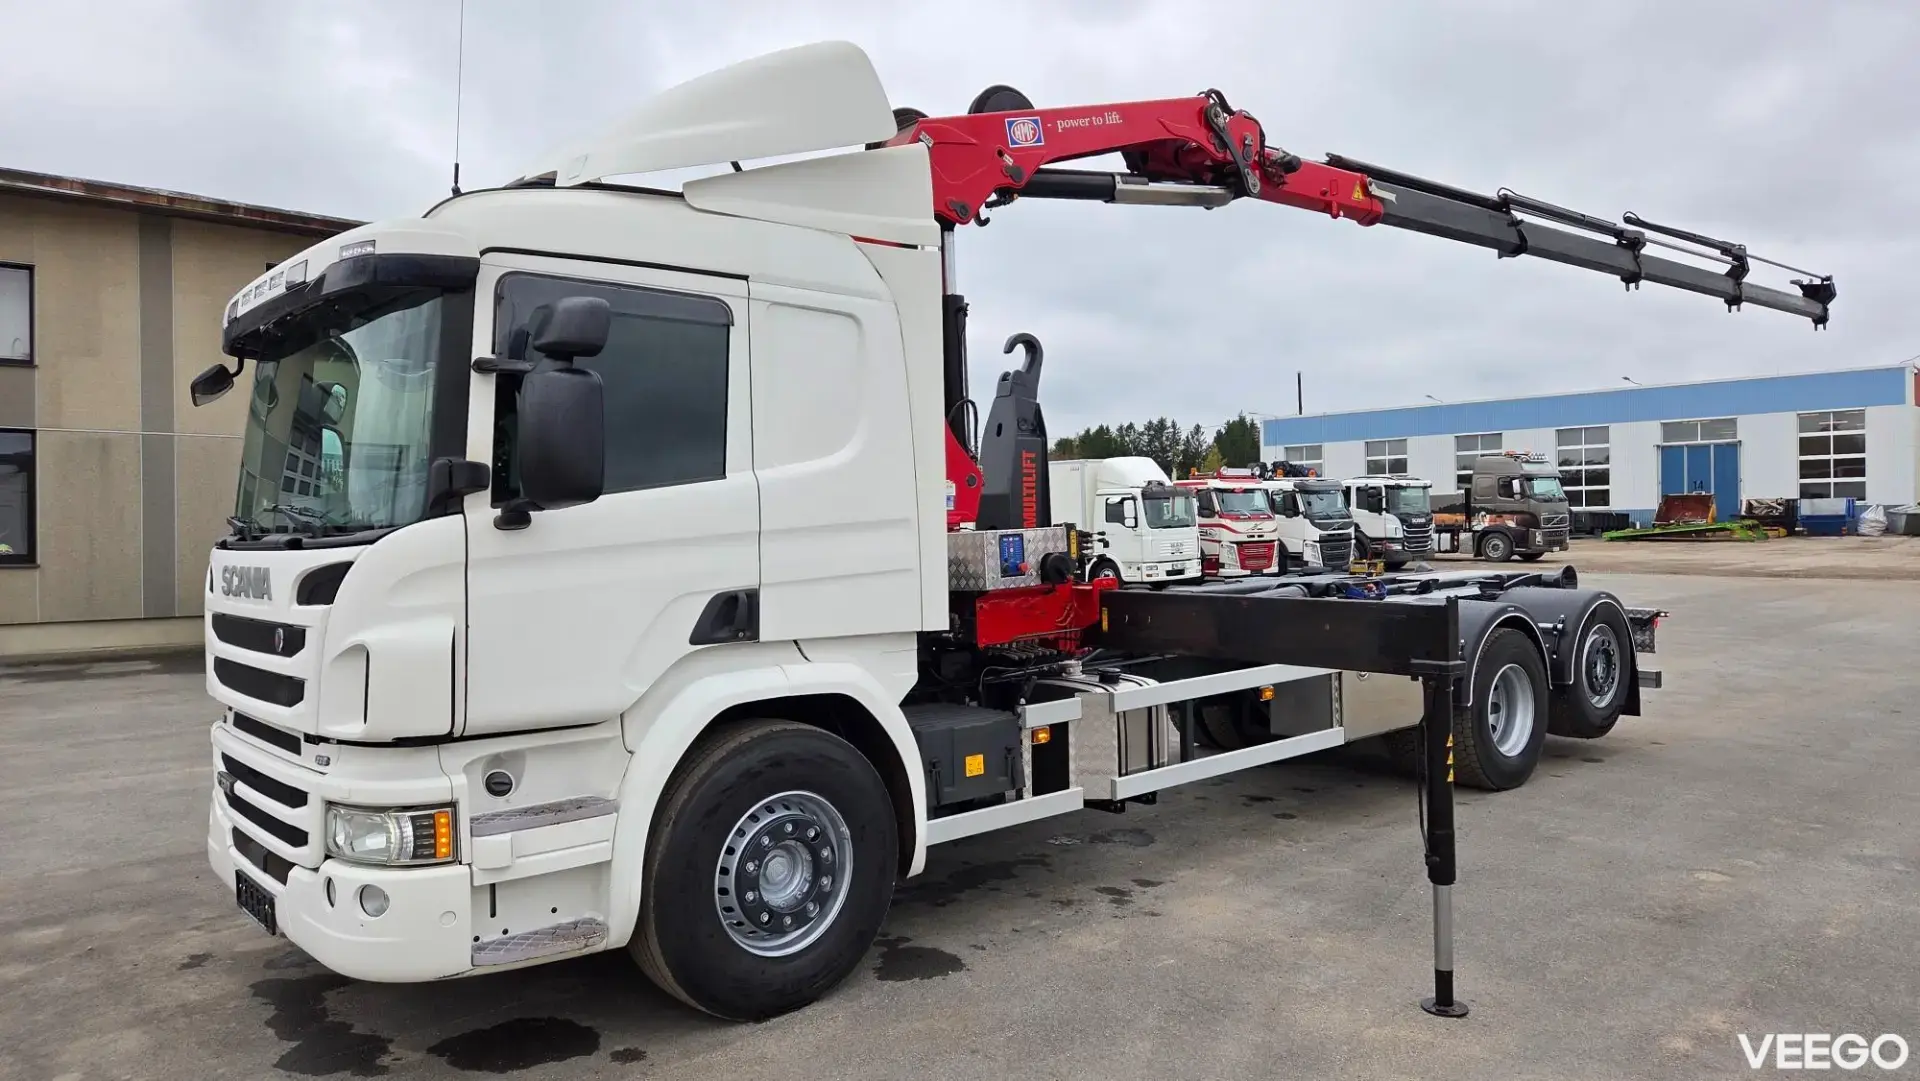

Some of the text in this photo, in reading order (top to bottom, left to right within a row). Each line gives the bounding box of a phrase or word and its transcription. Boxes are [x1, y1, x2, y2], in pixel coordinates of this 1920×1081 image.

[1014, 122, 1035, 142] HMF
[1057, 117, 1090, 132] power
[1092, 116, 1103, 126] to
[1104, 111, 1123, 125] lift.
[1023, 450, 1036, 528] MULTILIFT
[222, 565, 272, 601] SCANIA
